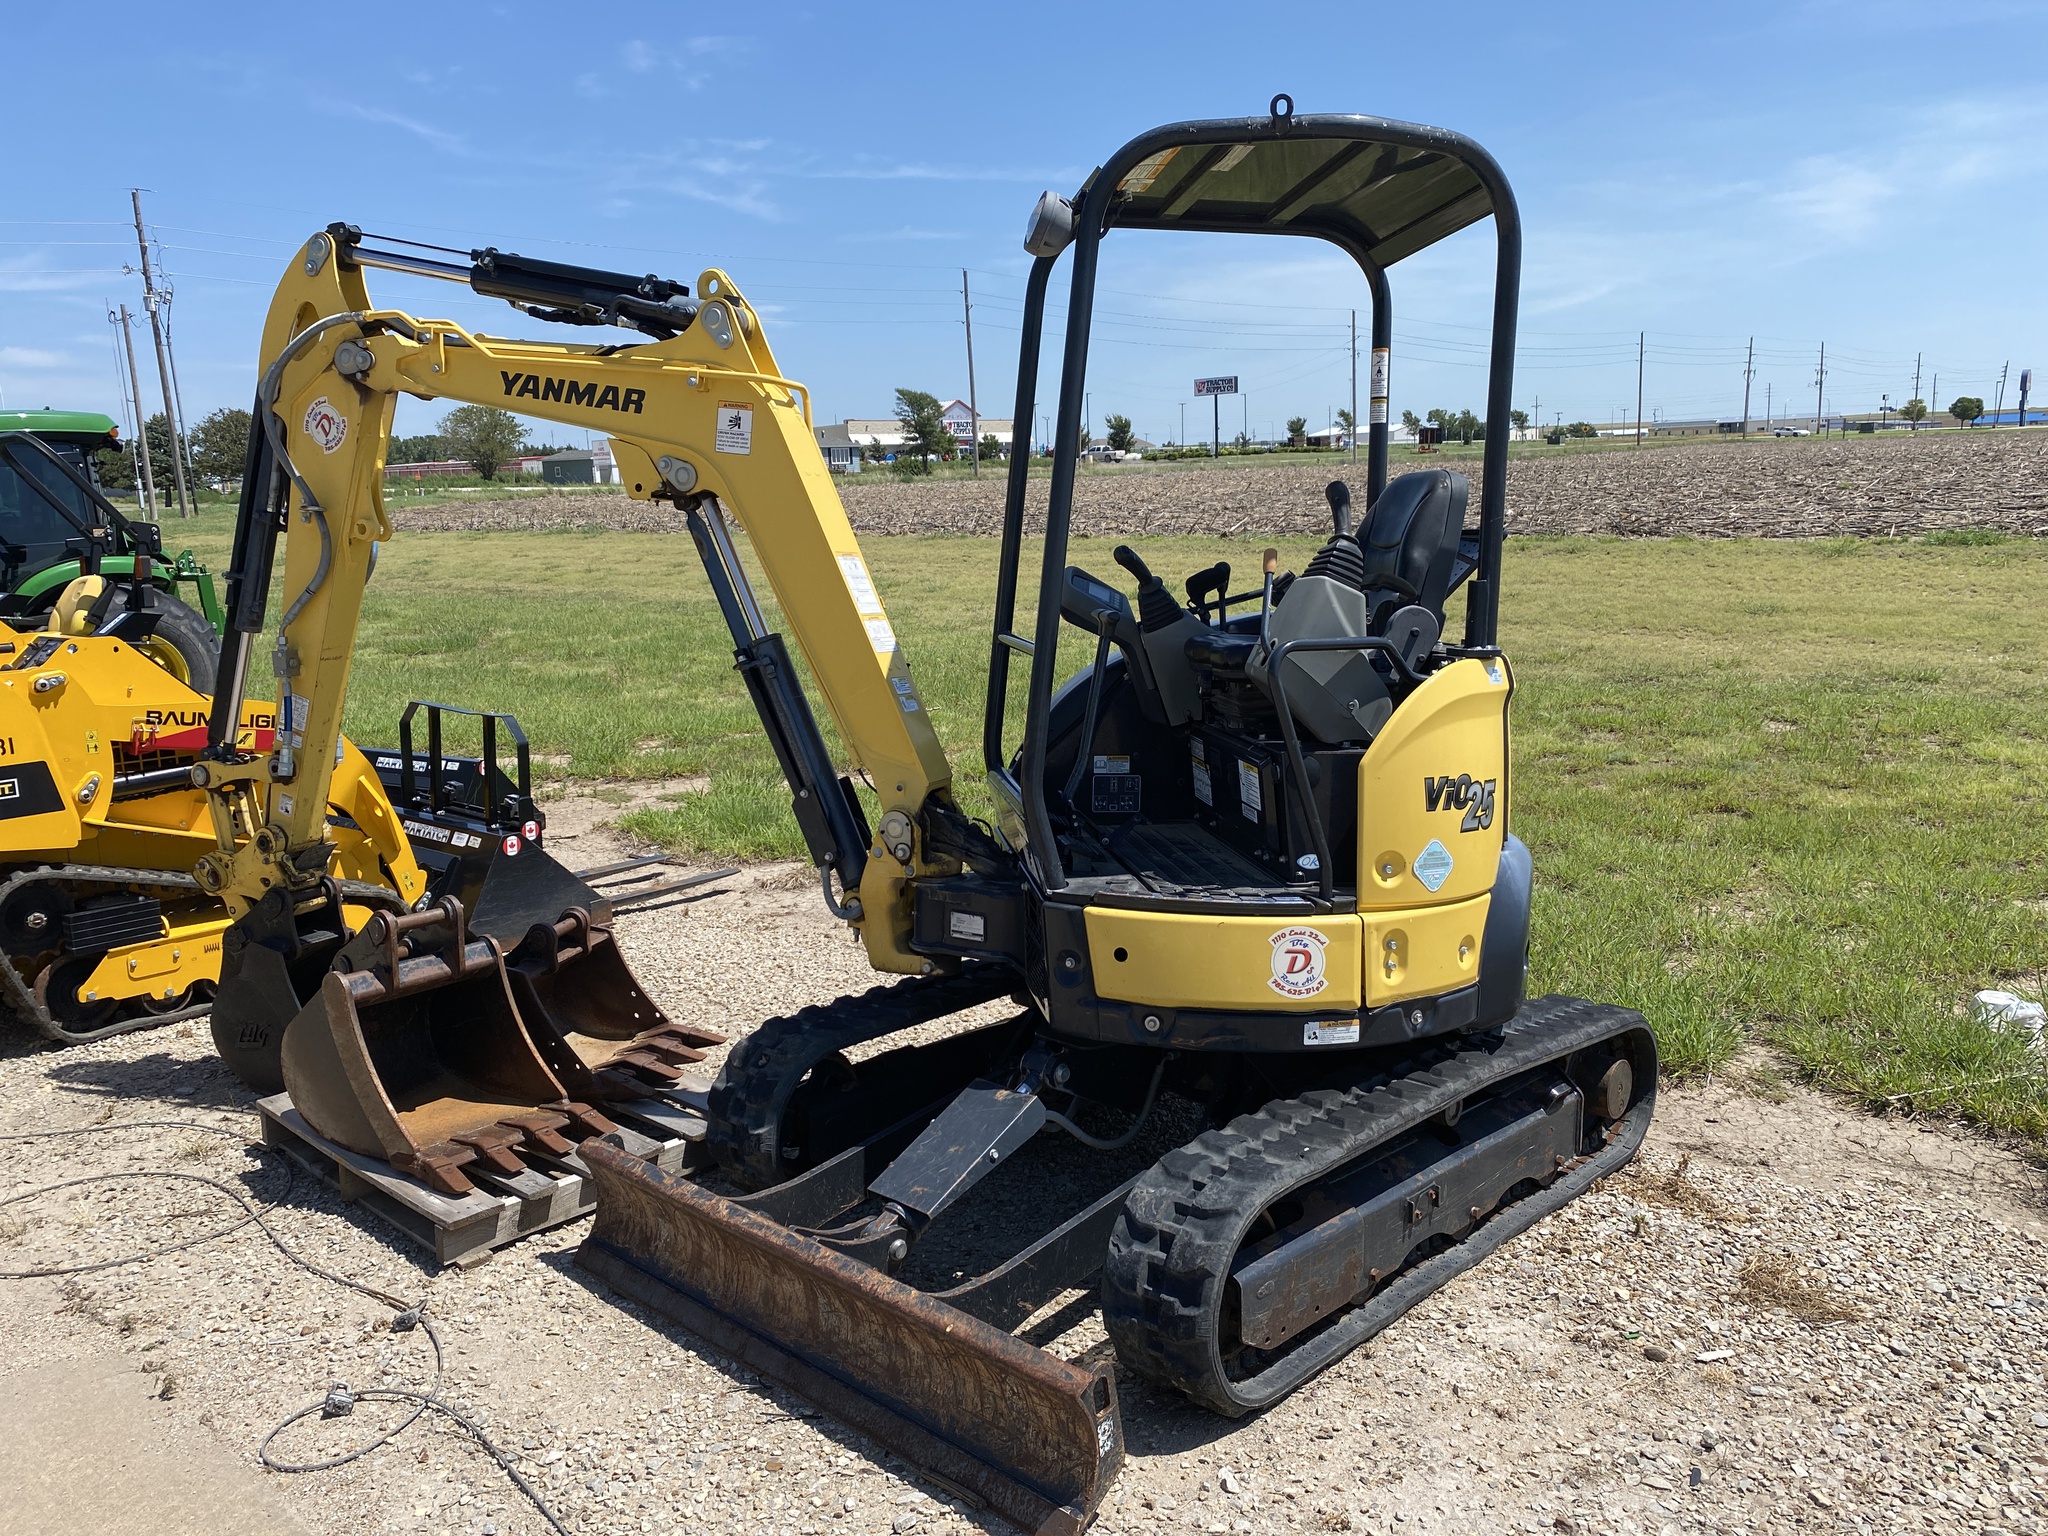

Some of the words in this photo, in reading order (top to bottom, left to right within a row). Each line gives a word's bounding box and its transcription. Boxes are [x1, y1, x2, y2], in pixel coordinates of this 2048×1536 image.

[500, 371, 646, 414] YANMAR
[1302, 856, 1319, 866] OK
[1272, 932, 1287, 945] 1110
[1308, 931, 1327, 946] 22nd
[1289, 939, 1310, 948] Big
[1281, 973, 1299, 986] Rent
[1302, 974, 1316, 986] All
